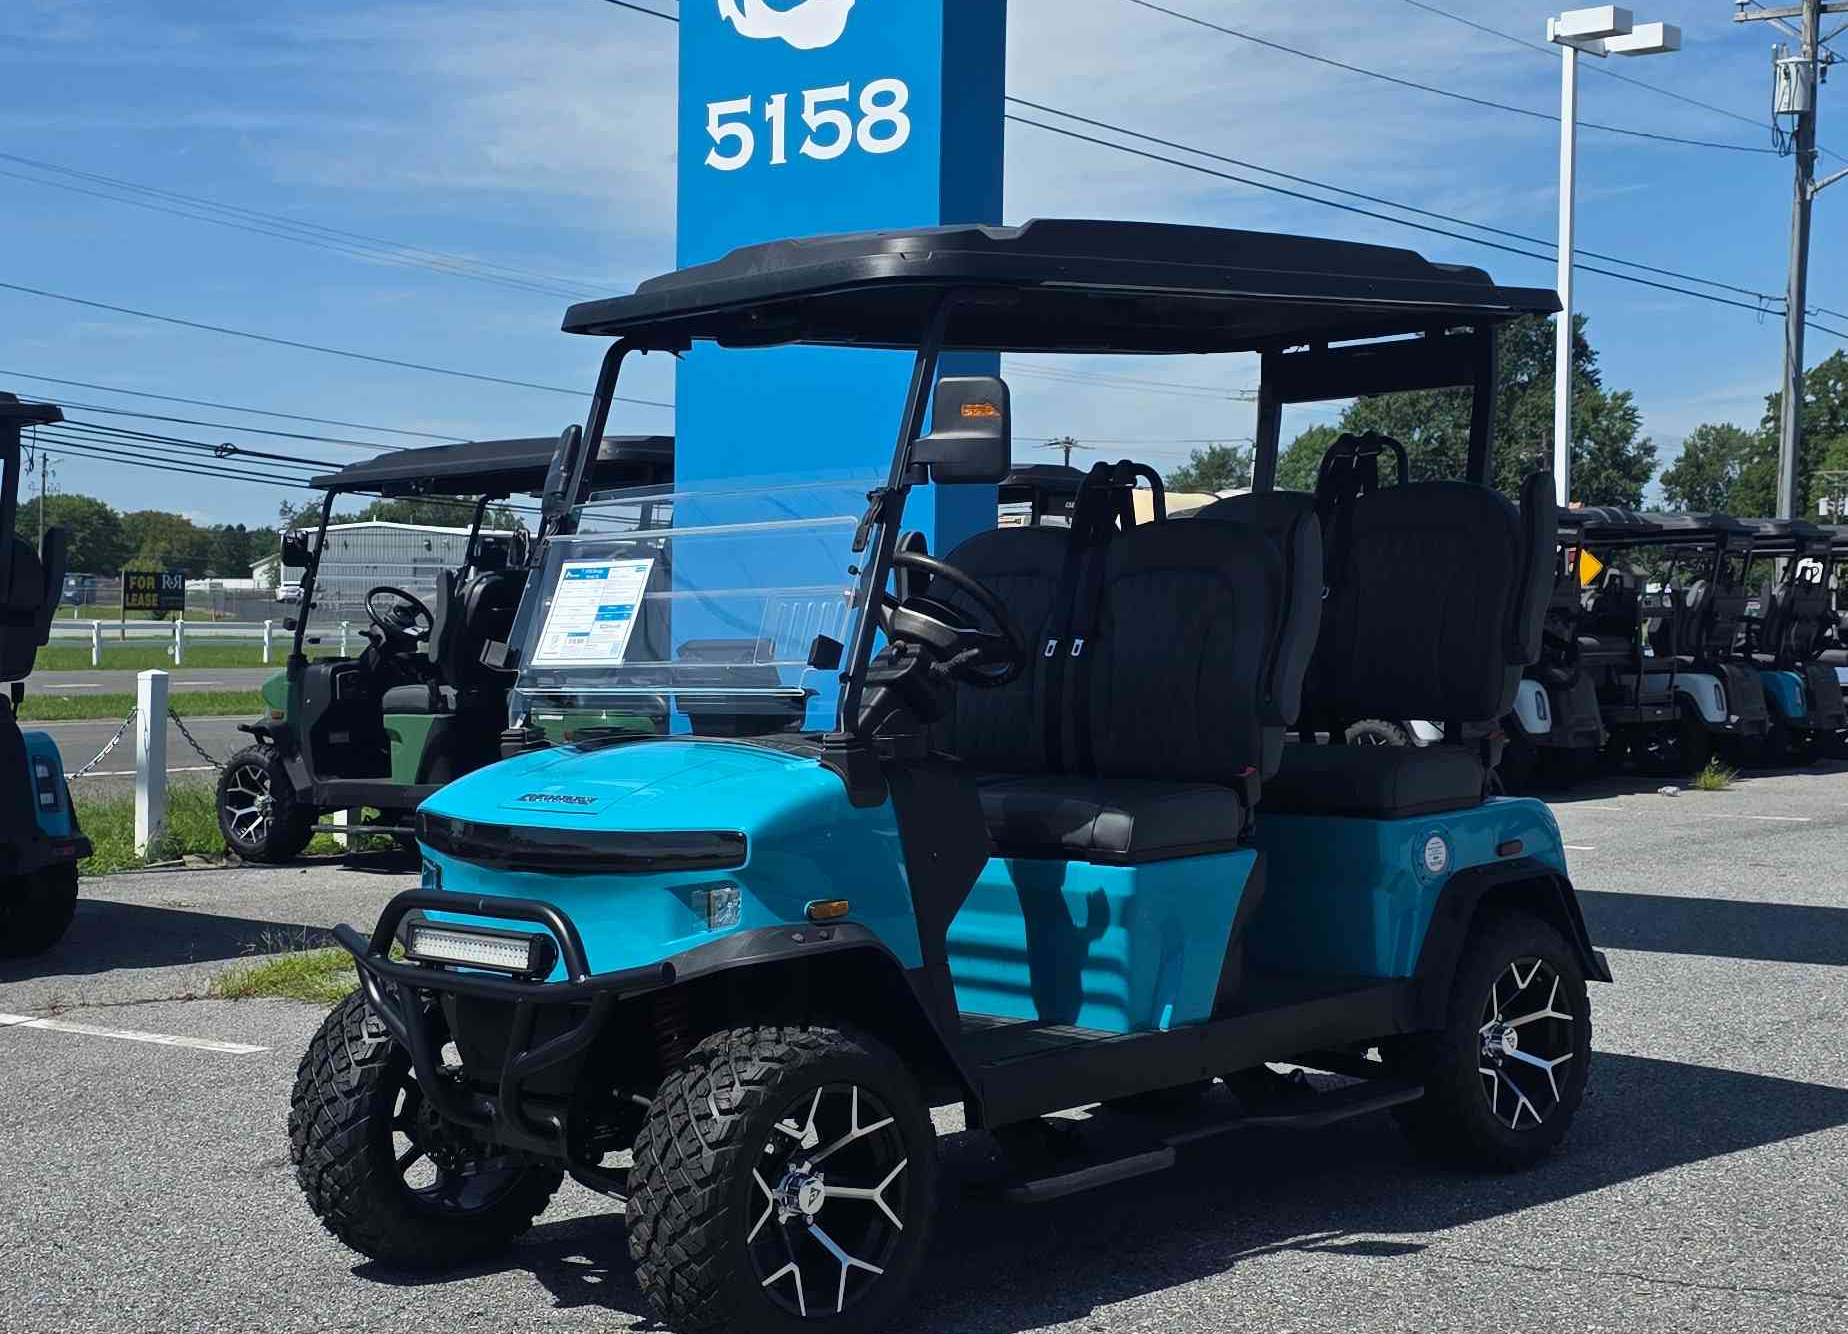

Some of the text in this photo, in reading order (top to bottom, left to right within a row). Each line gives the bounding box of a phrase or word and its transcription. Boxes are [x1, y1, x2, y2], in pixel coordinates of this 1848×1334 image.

[704, 77, 911, 171] 5158
[128, 575, 155, 590] FOR
[125, 592, 160, 606] LEASE
